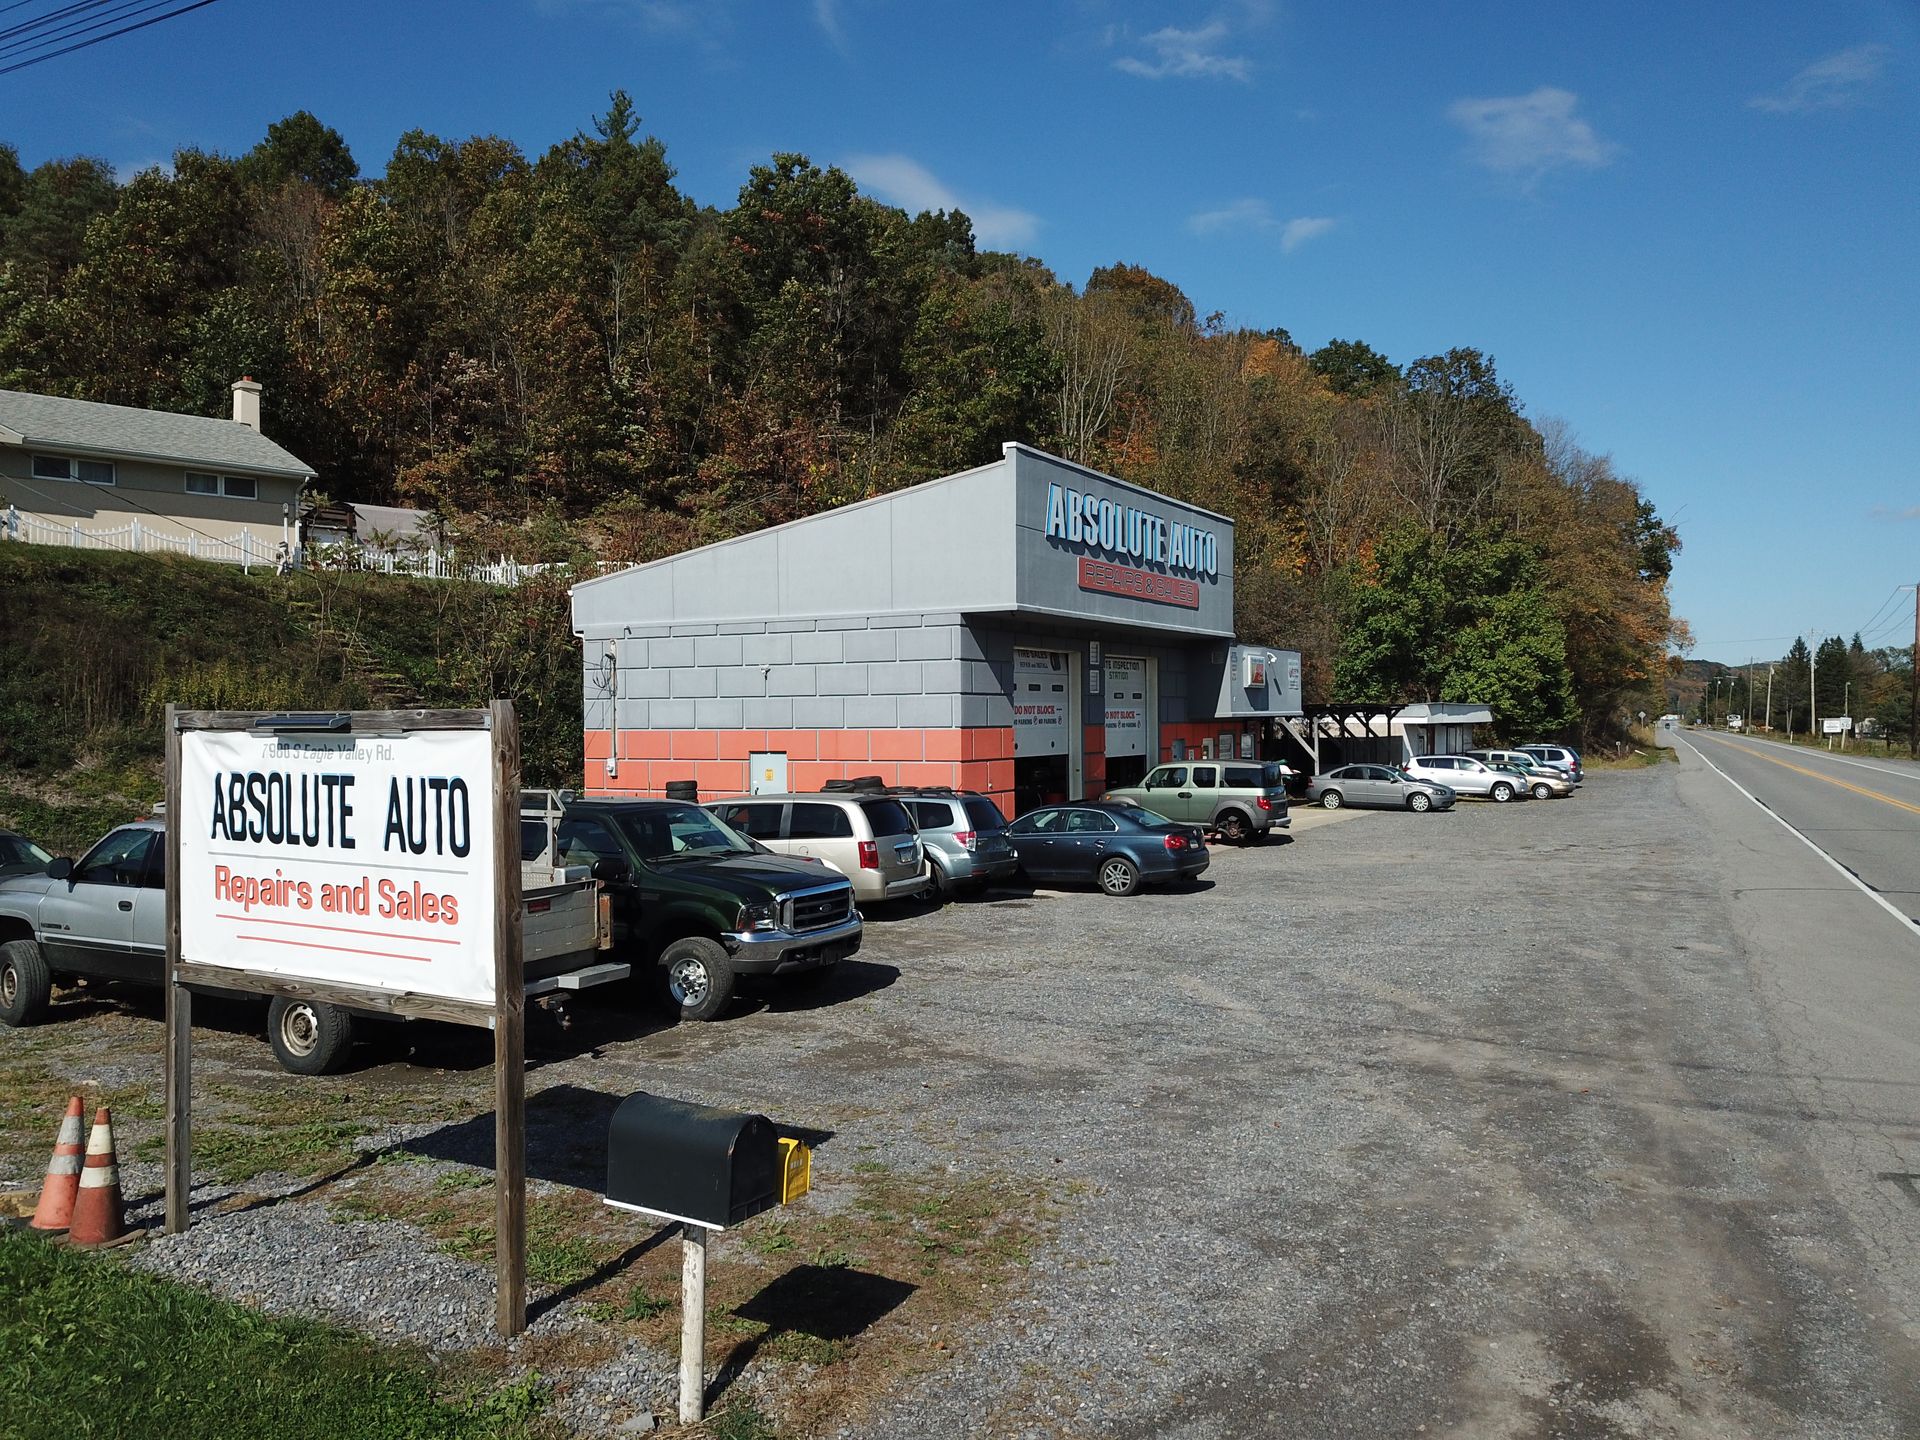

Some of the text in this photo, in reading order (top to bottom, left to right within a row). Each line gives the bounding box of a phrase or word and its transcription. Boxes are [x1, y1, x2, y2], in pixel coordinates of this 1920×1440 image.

[1044, 481, 1218, 576] ABSOLUTE AUTO
[1084, 562, 1194, 602] REPAIRS & SALES
[1109, 671, 1128, 680] STATION
[1112, 661, 1140, 671] INSPECTION
[1014, 705, 1055, 715] DO NOT BLOCK
[1109, 711, 1119, 719] NOT
[1120, 711, 1136, 719] BLOCK
[293, 744, 301, 759] S
[303, 744, 334, 763] Eagle
[337, 743, 373, 764] Valley
[376, 744, 395, 761] Rd.
[211, 771, 471, 858] ABSOLUTE AUTO
[215, 865, 459, 925] Repairs and Sales
